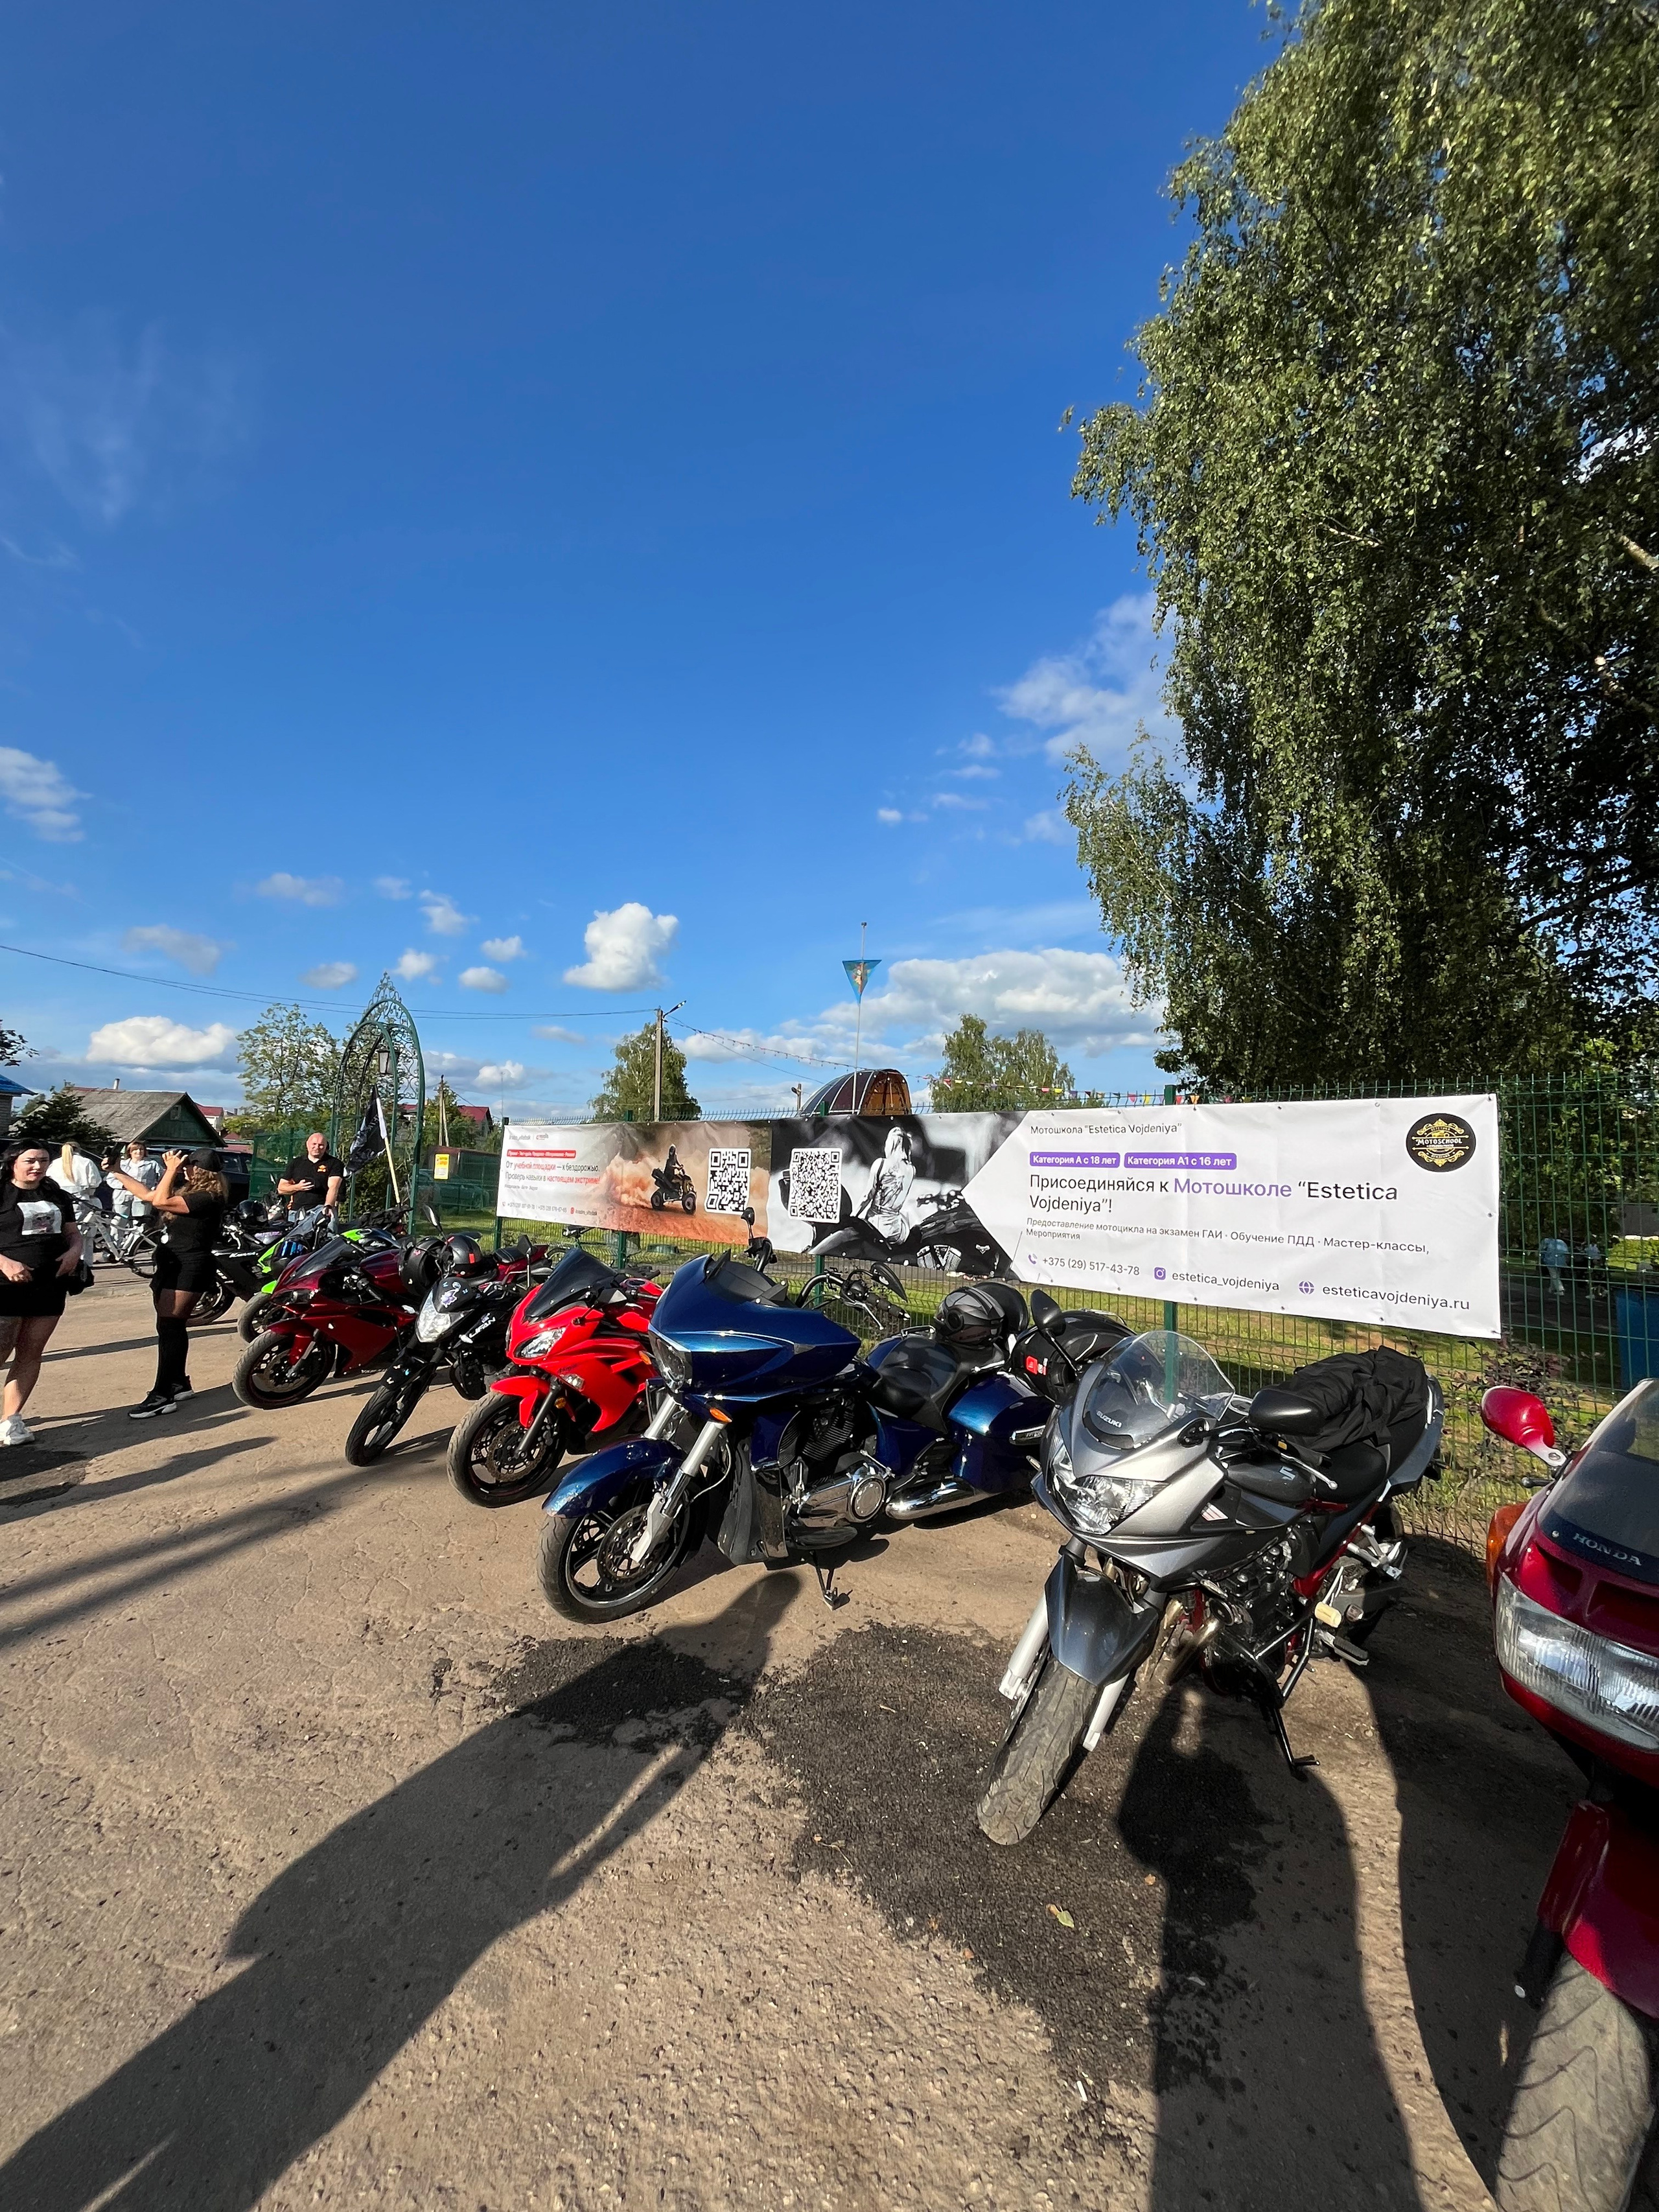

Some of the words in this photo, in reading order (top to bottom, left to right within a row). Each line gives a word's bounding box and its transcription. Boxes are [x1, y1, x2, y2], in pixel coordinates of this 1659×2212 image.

[1030, 1126, 1083, 1134] Мотошкола
[1415, 1137, 1463, 1146] MOTOSCHOOL
[1032, 1155, 1074, 1166] Категория
[1090, 1156, 1100, 1164] 18
[1128, 1156, 1176, 1167] Категория
[1199, 1157, 1211, 1166] 16
[1030, 1174, 1154, 1192] Присоединяйся
[1160, 1181, 1168, 1192] к
[1174, 1178, 1292, 1197] Мотошколе
[1026, 1229, 1080, 1240] Мероприятия
[1027, 1218, 1094, 1230] Предоставление
[1096, 1224, 1144, 1234] мотоцикла
[1159, 1228, 1200, 1237] экзамен
[1202, 1230, 1222, 1239] ГАИ
[1231, 1231, 1284, 1243] Обучение
[1287, 1235, 1314, 1247] ПДД
[1323, 1237, 1429, 1254] Мастер-классы,
[1042, 1257, 1065, 1268] +375
[1067, 1258, 1087, 1270] (29)
[1089, 1261, 1140, 1276] 517-43-78
[1172, 1271, 1279, 1292] estetica_vojdeniya
[1323, 1286, 1470, 1309] esteticavojdeniya.ru
[469, 1316, 496, 1338] LIFAN
[1096, 1410, 1122, 1428] SUZUKI
[1572, 1533, 1642, 1566] HONDA
